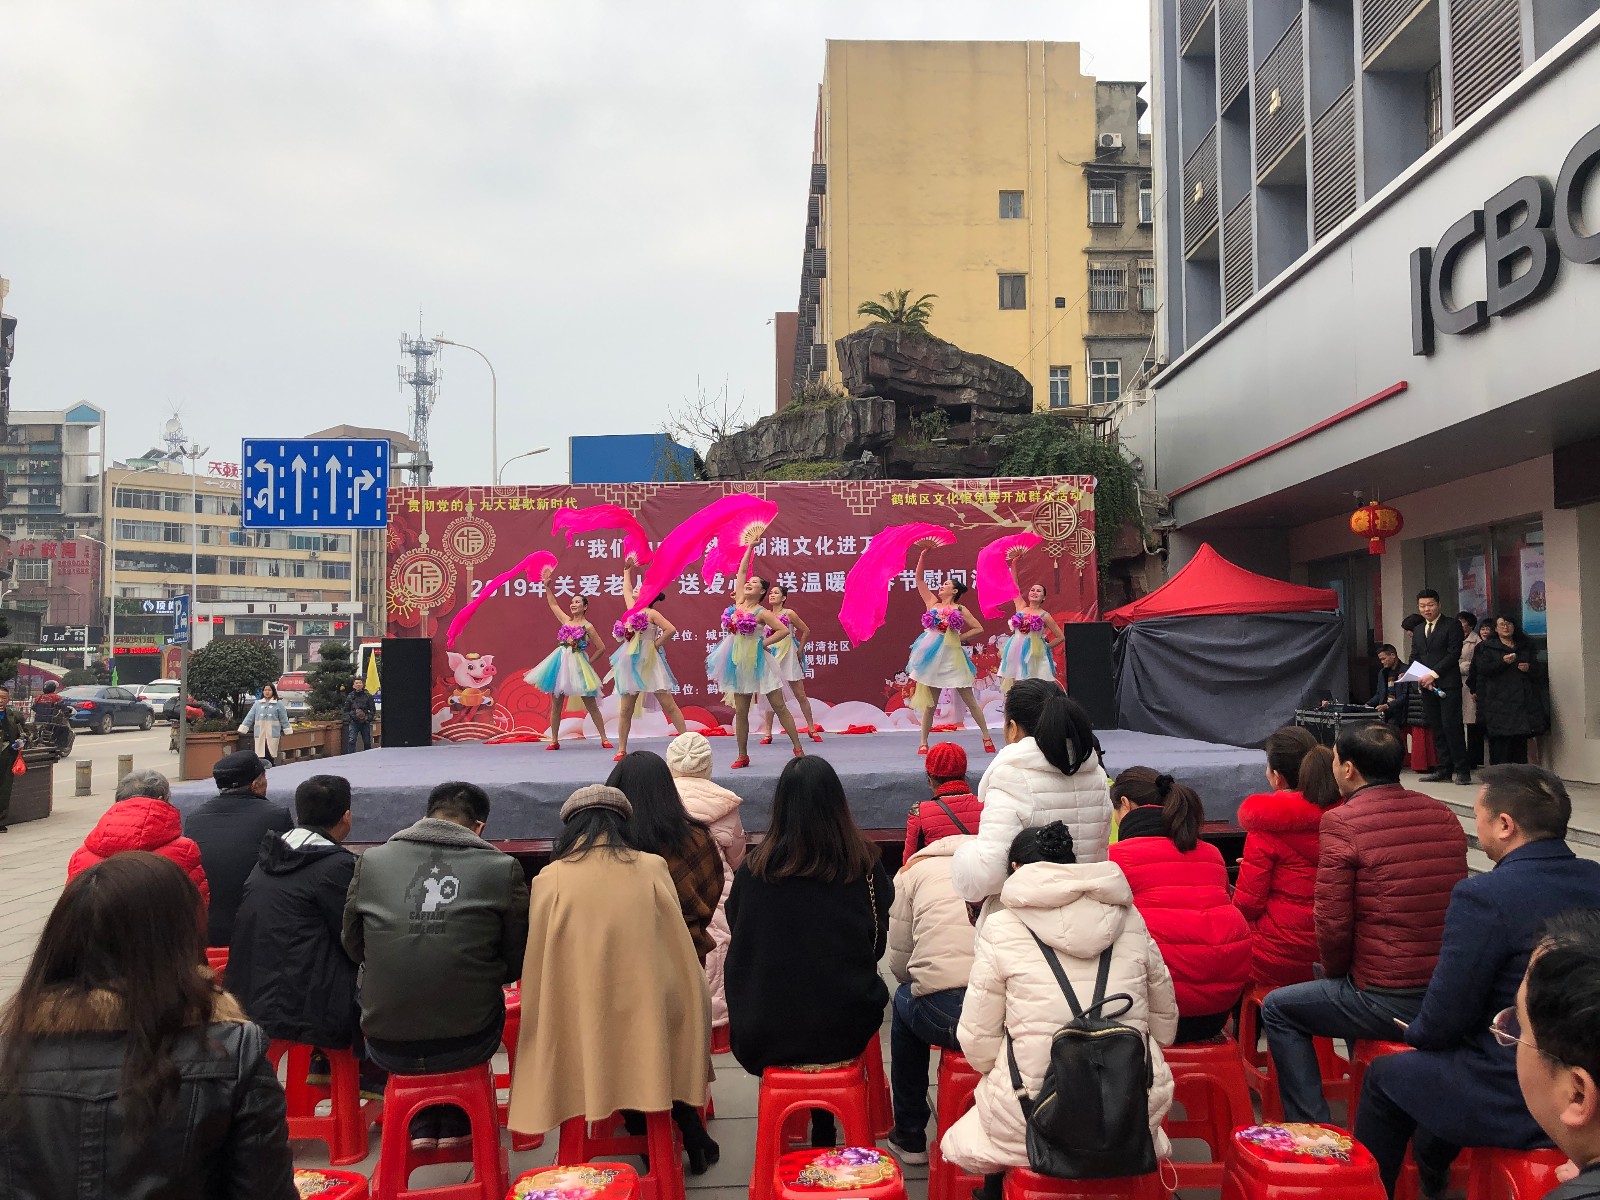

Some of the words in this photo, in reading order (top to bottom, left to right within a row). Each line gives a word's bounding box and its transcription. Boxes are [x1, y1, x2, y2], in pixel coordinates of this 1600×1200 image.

[1410, 124, 1600, 356] ICBC
[408, 497, 578, 512] 贯彻党的十九大讴歌新时代
[890, 490, 1082, 506] 鹤城区文化馆免费开放群众活动
